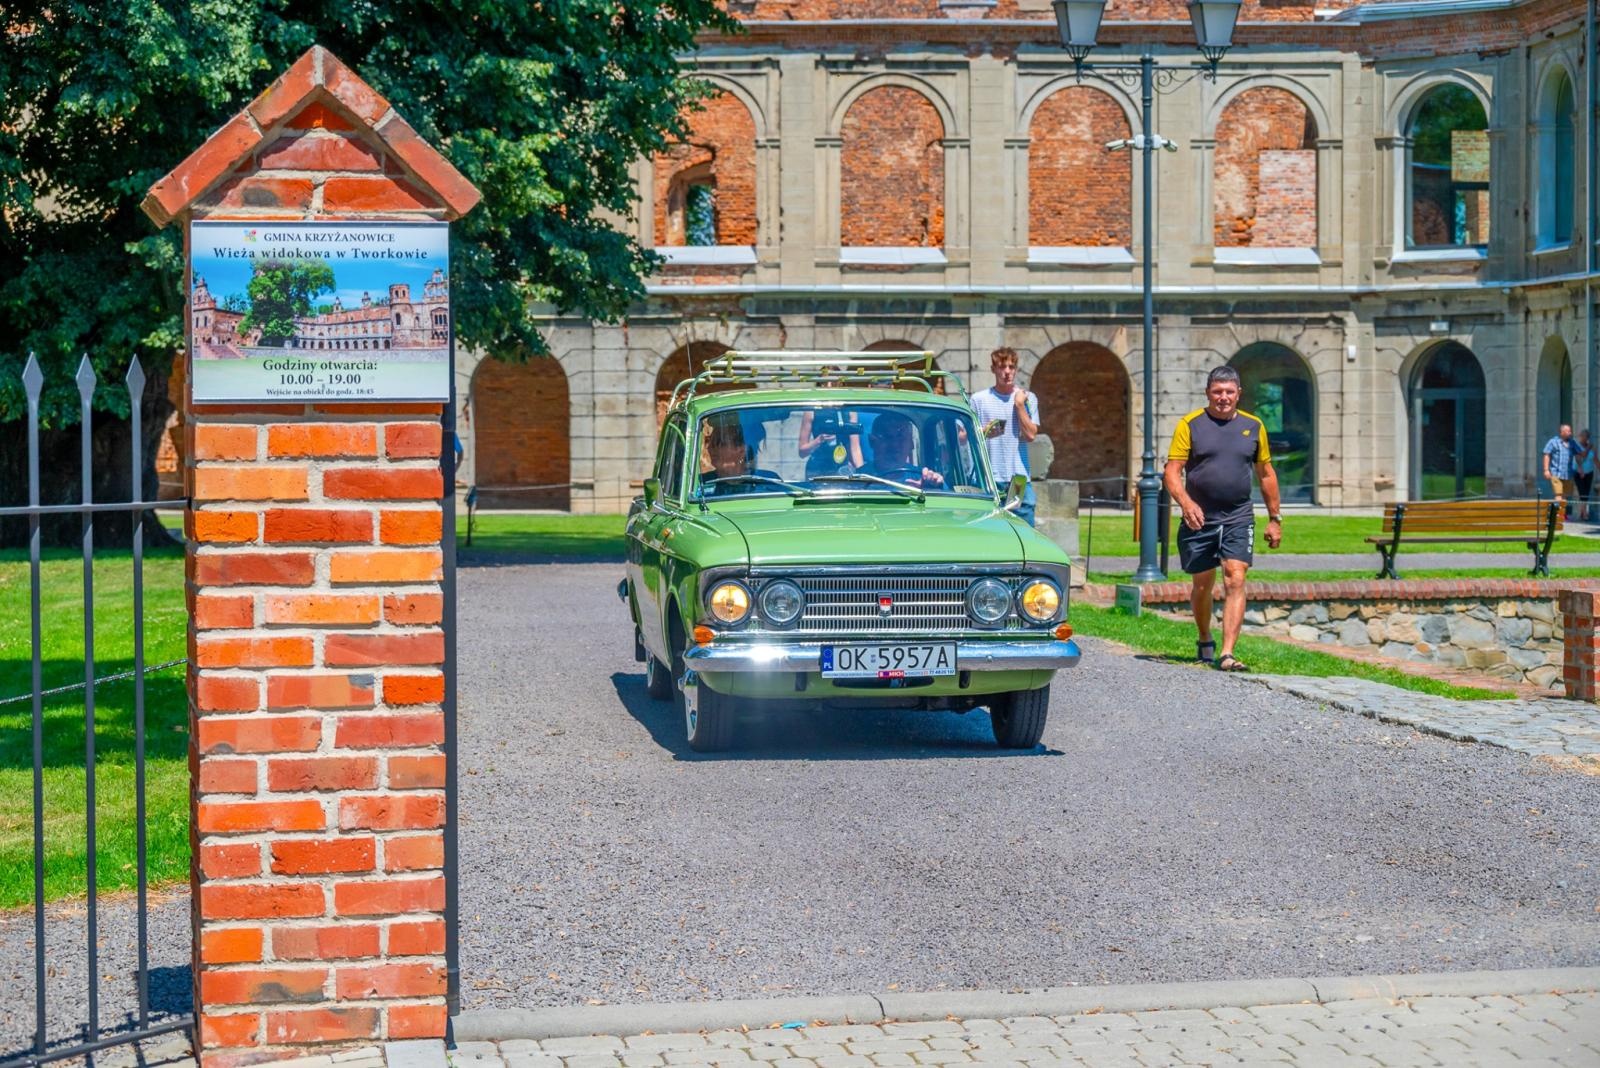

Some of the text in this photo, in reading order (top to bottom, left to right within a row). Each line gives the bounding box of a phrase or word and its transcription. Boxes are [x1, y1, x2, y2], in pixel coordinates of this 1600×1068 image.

[264, 231, 396, 242] GMINA KRZYŻANOWICE
[213, 247, 428, 259] Wieża widokowa w Tworkowie
[262, 359, 378, 374] Godziny otwarcia:
[280, 374, 314, 385] 10.00
[328, 373, 362, 385] 19.00
[266, 388, 293, 396] Wejście
[336, 388, 354, 396] godz.
[838, 646, 949, 671] OK 5957A
